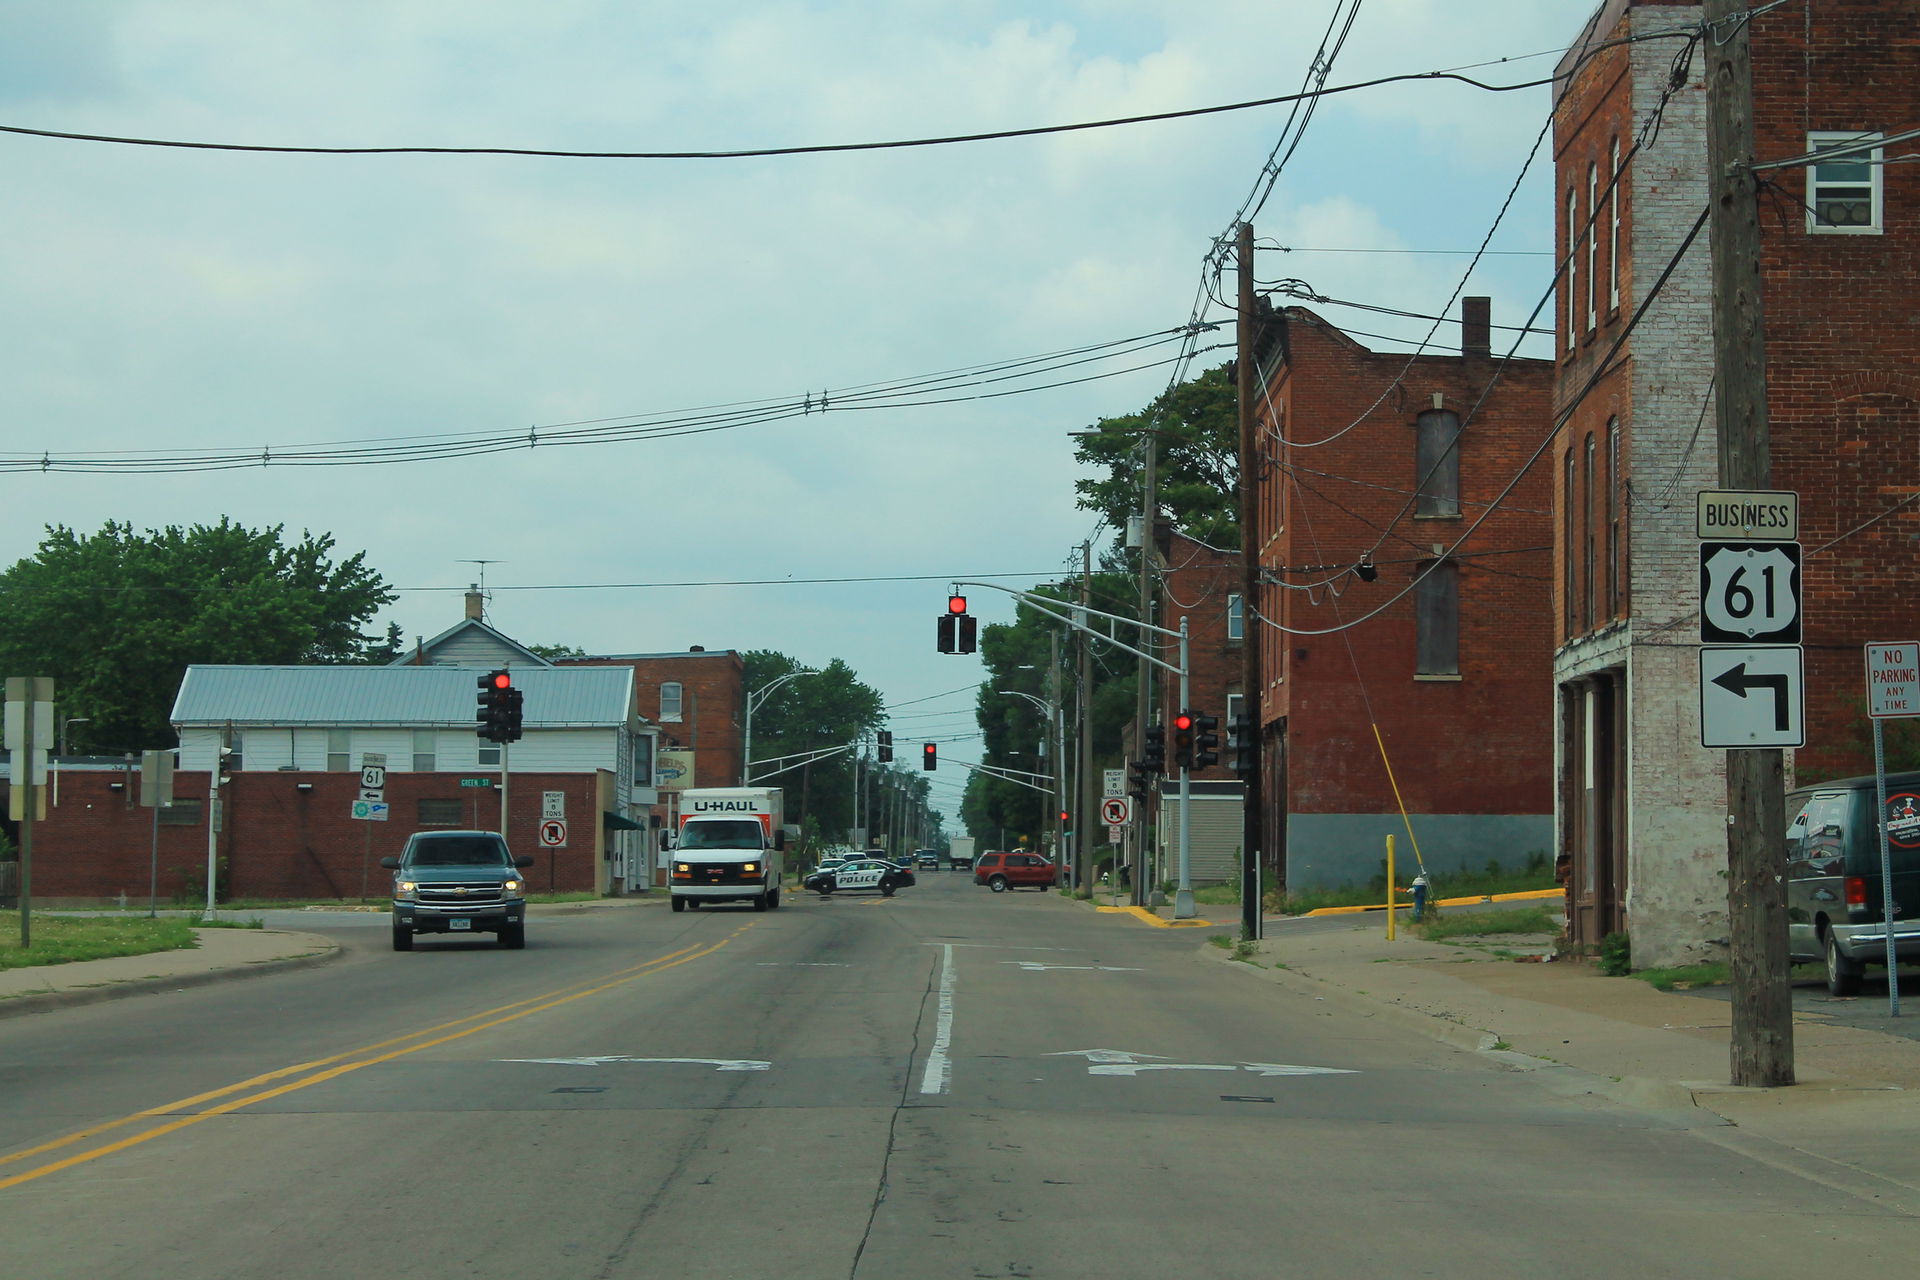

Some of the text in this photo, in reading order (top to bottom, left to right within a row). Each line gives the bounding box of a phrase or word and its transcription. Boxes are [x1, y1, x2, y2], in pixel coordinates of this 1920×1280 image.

[1706, 503, 1789, 528] BUSINESS
[1724, 565, 1775, 619] 61
[1884, 649, 1903, 664] NO
[1873, 668, 1916, 684] PARKING
[1885, 686, 1905, 697] ANY
[1884, 700, 1908, 710] TIME
[366, 770, 379, 784] 61
[694, 801, 758, 811] U-HAUL
[839, 875, 879, 884] POLICE
